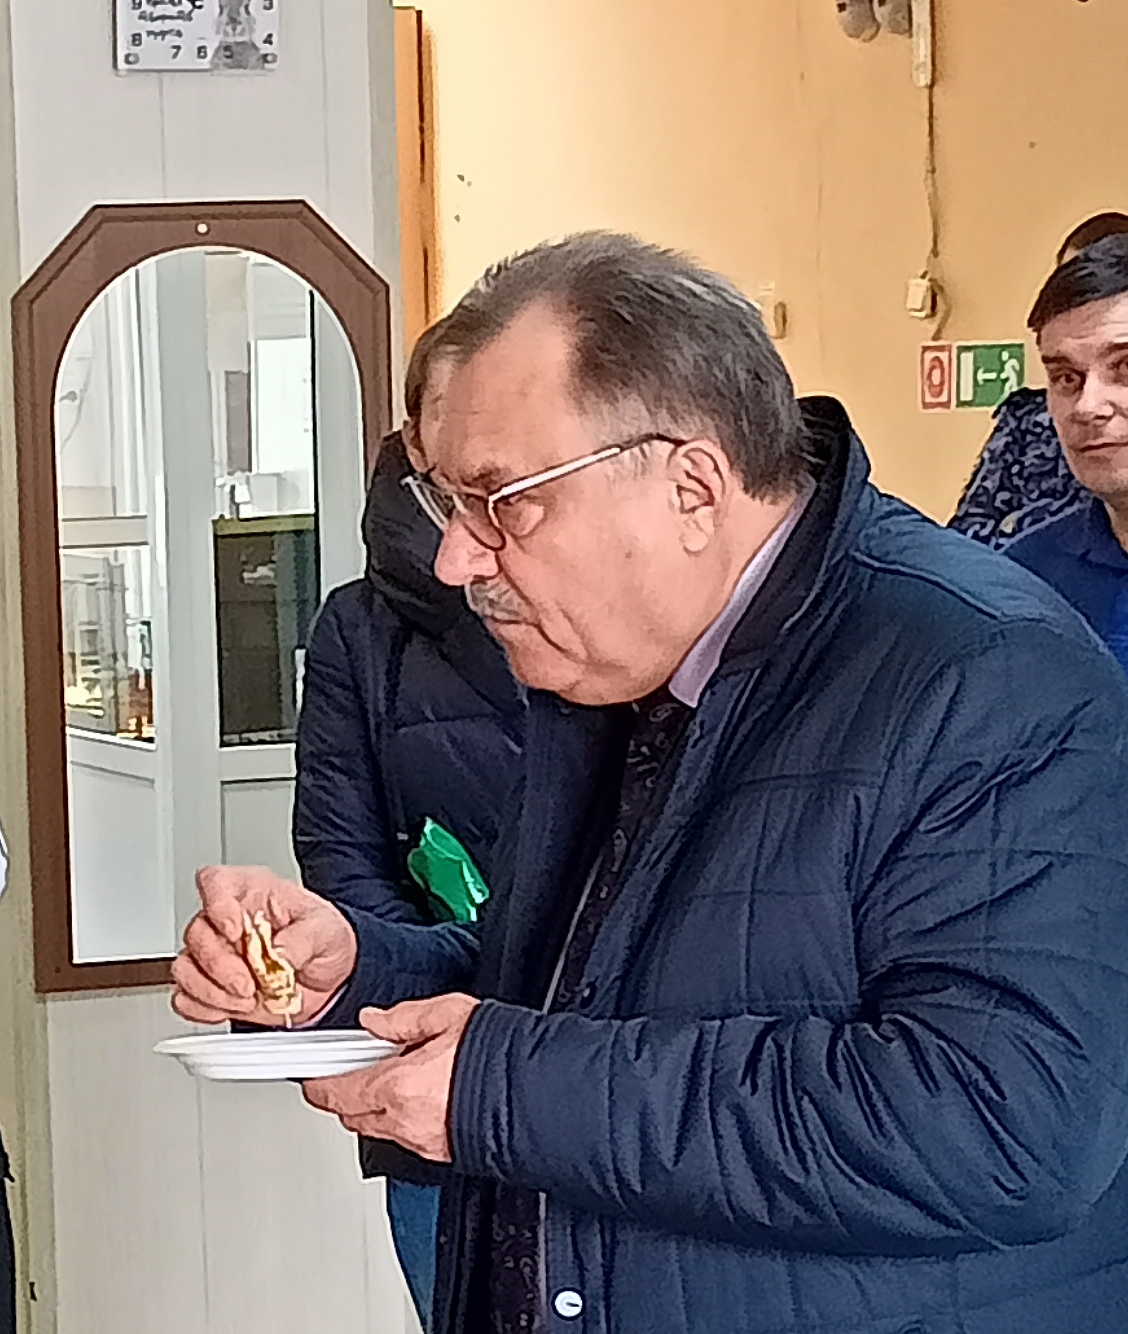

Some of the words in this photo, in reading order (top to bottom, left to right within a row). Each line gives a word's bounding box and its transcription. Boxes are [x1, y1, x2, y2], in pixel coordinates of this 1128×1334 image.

[131, 33, 142, 47] 8
[263, 33, 273, 45] 4
[171, 45, 182, 59] 7
[197, 45, 208, 59] 6
[223, 45, 233, 59] 5
